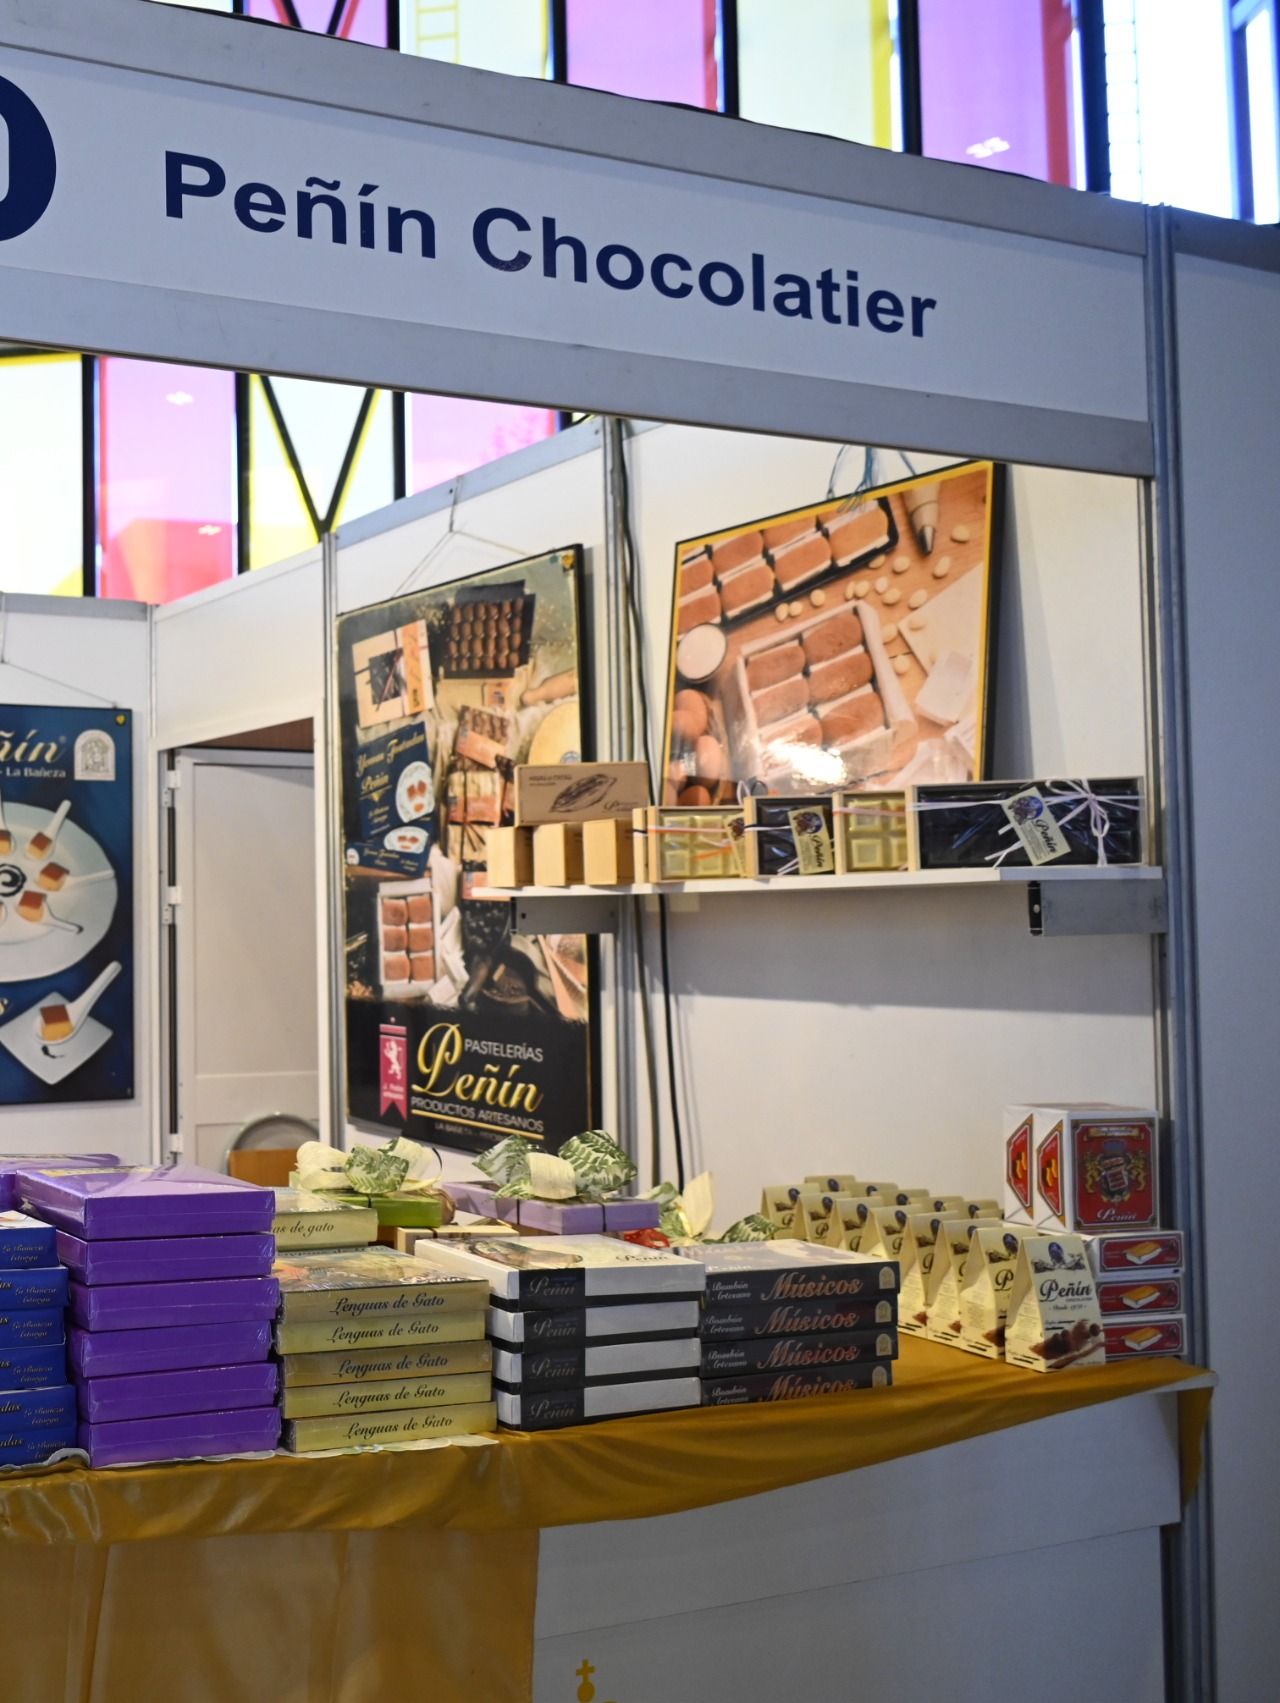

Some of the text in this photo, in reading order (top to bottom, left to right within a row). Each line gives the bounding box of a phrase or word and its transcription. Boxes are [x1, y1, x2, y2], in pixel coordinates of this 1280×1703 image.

[164, 150, 936, 339] Peñín Chocolatier
[6, 767, 20, 777] La
[464, 1039, 543, 1062] PASTELERÍAS
[411, 1022, 543, 1112] Peñín
[411, 1097, 544, 1132] PRODUCTOS ARTESANOS
[290, 1221, 305, 1233] de
[303, 1223, 335, 1237] gato
[761, 1272, 864, 1300] Músicos
[1039, 1278, 1091, 1302] Peñín
[329, 1292, 445, 1316] Lenguas de Gato
[327, 1320, 439, 1344] Lenguas de Gato
[754, 1306, 860, 1334] Músicos
[333, 1352, 449, 1378] Lenguas de Gato
[757, 1339, 860, 1369] Músicos
[333, 1384, 445, 1408] Lenguas de Gato
[342, 1415, 453, 1440] Lenguas de Gato
